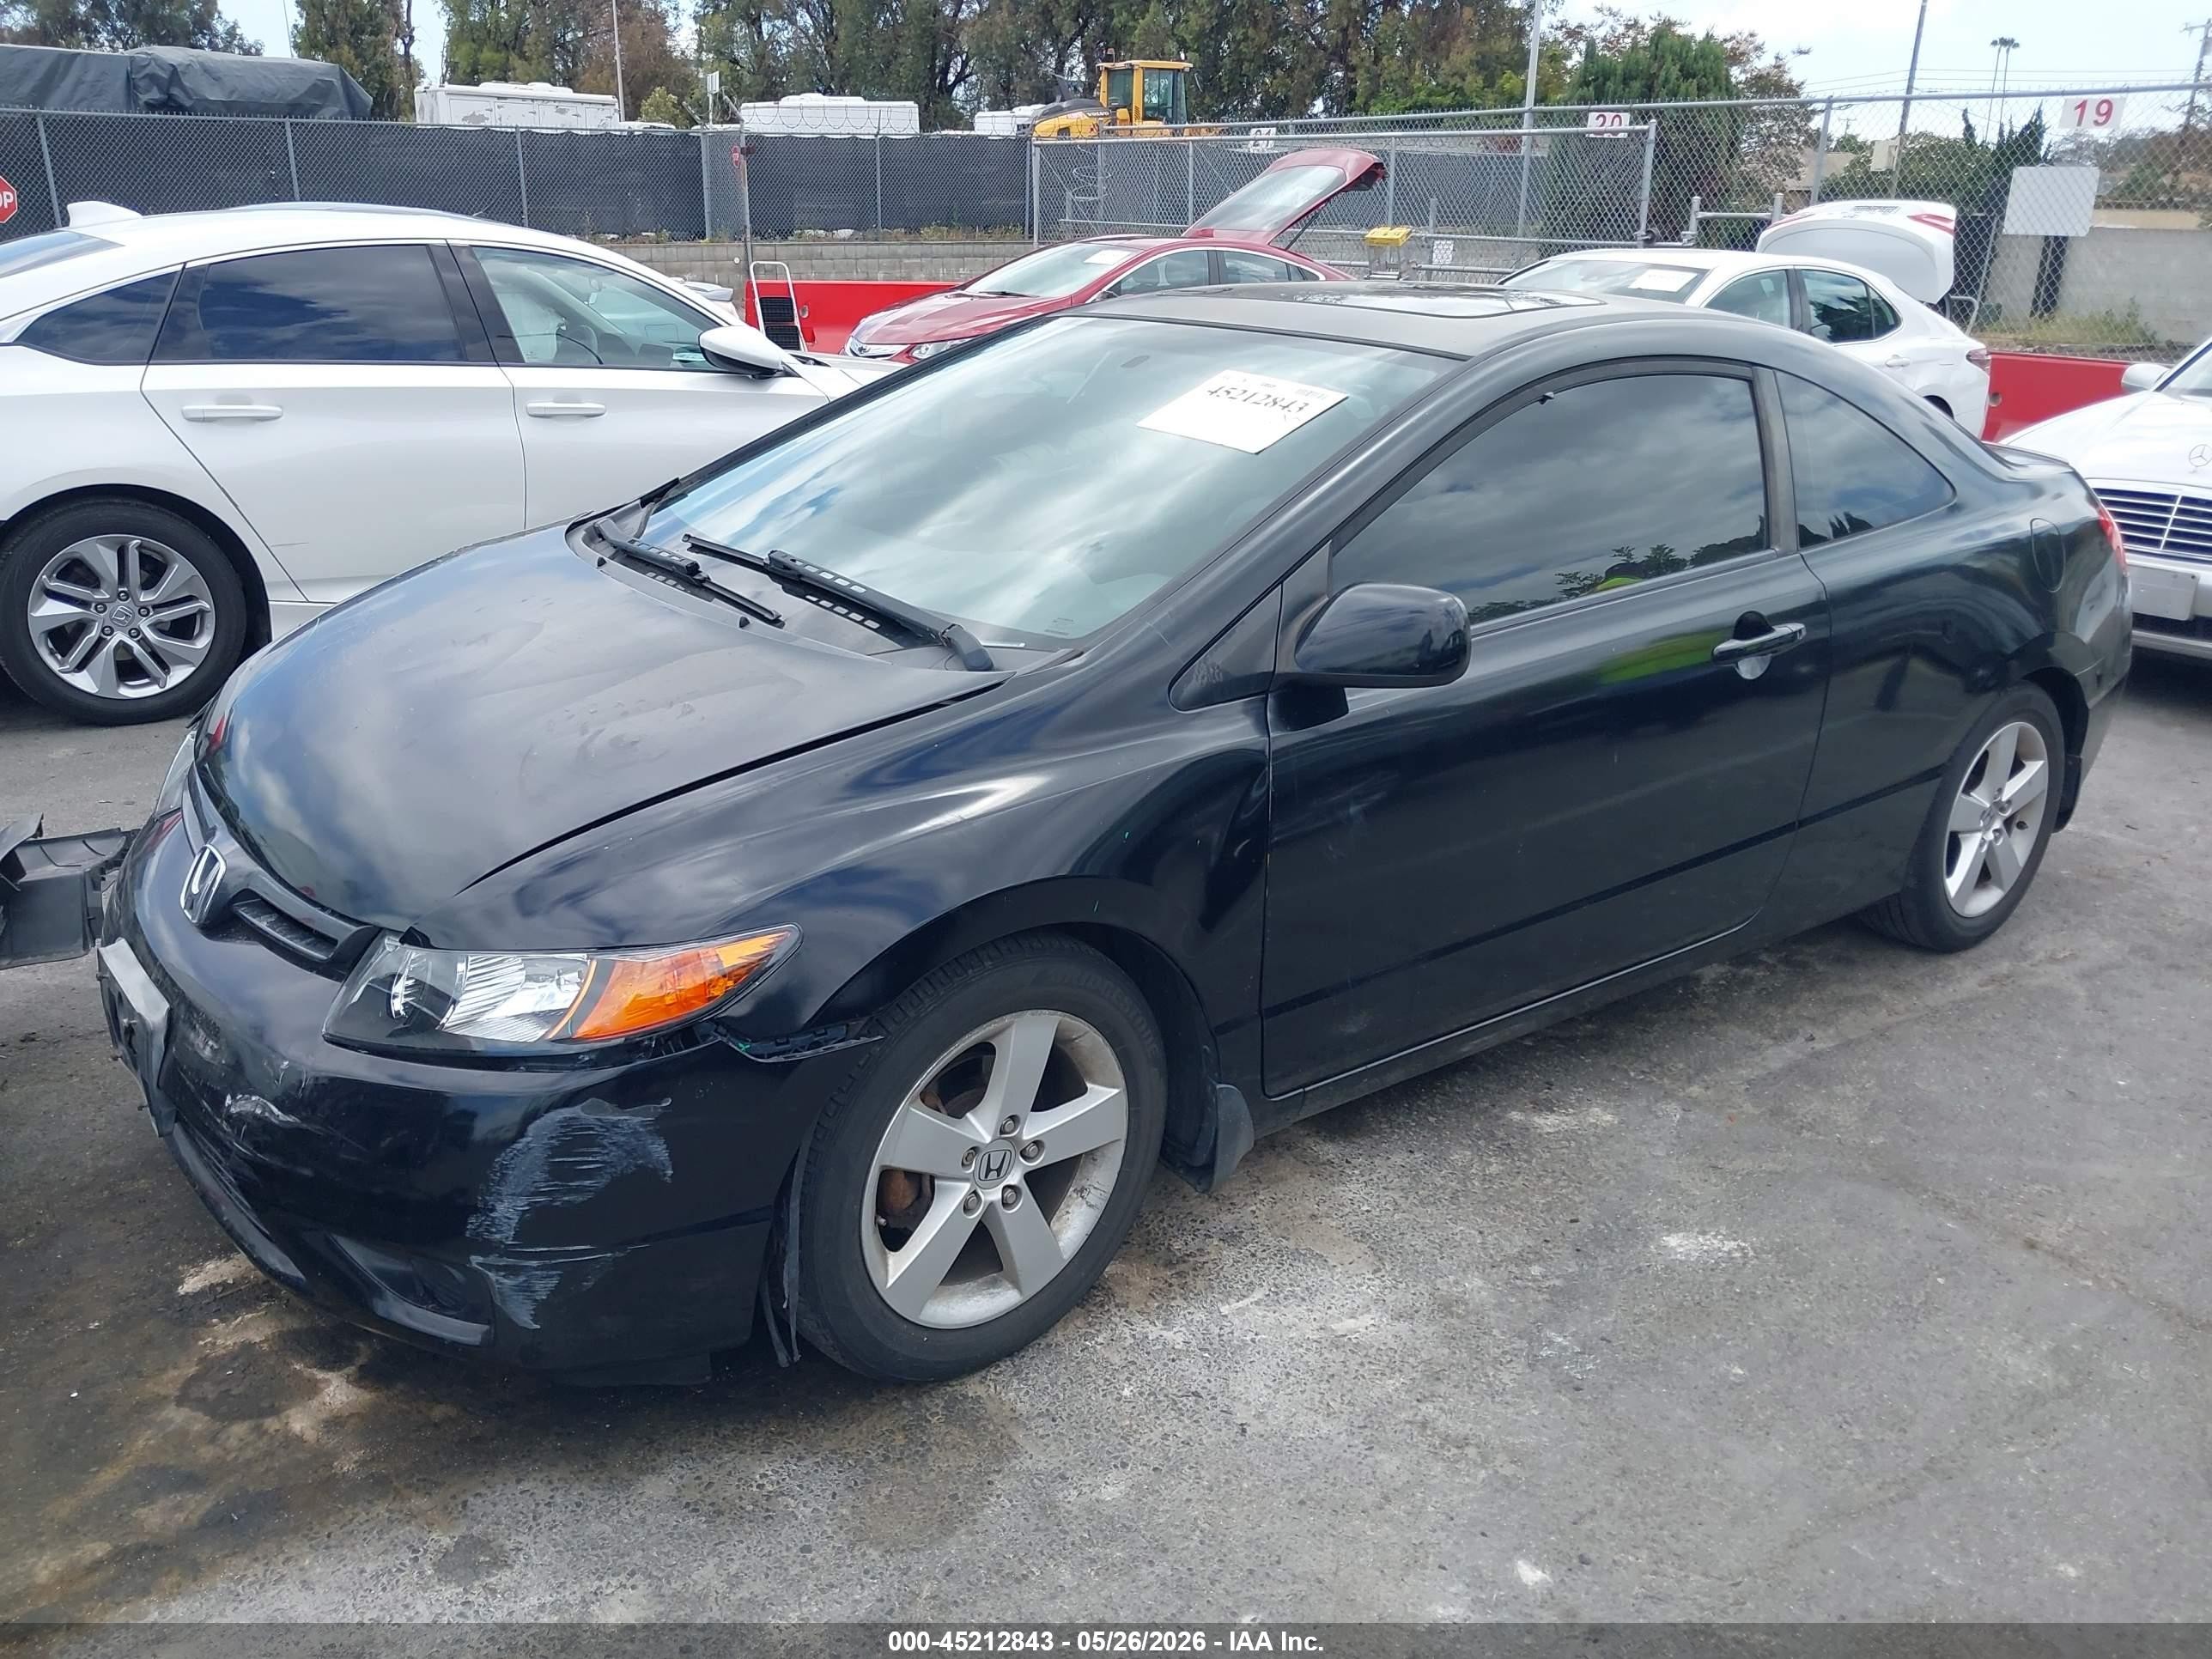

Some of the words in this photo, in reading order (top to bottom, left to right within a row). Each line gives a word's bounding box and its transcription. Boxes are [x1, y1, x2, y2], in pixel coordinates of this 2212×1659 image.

[1595, 113, 1623, 137] 20
[2074, 99, 2113, 127] 19
[1253, 129, 1272, 147] 21
[1207, 386, 1310, 413] 45212843
